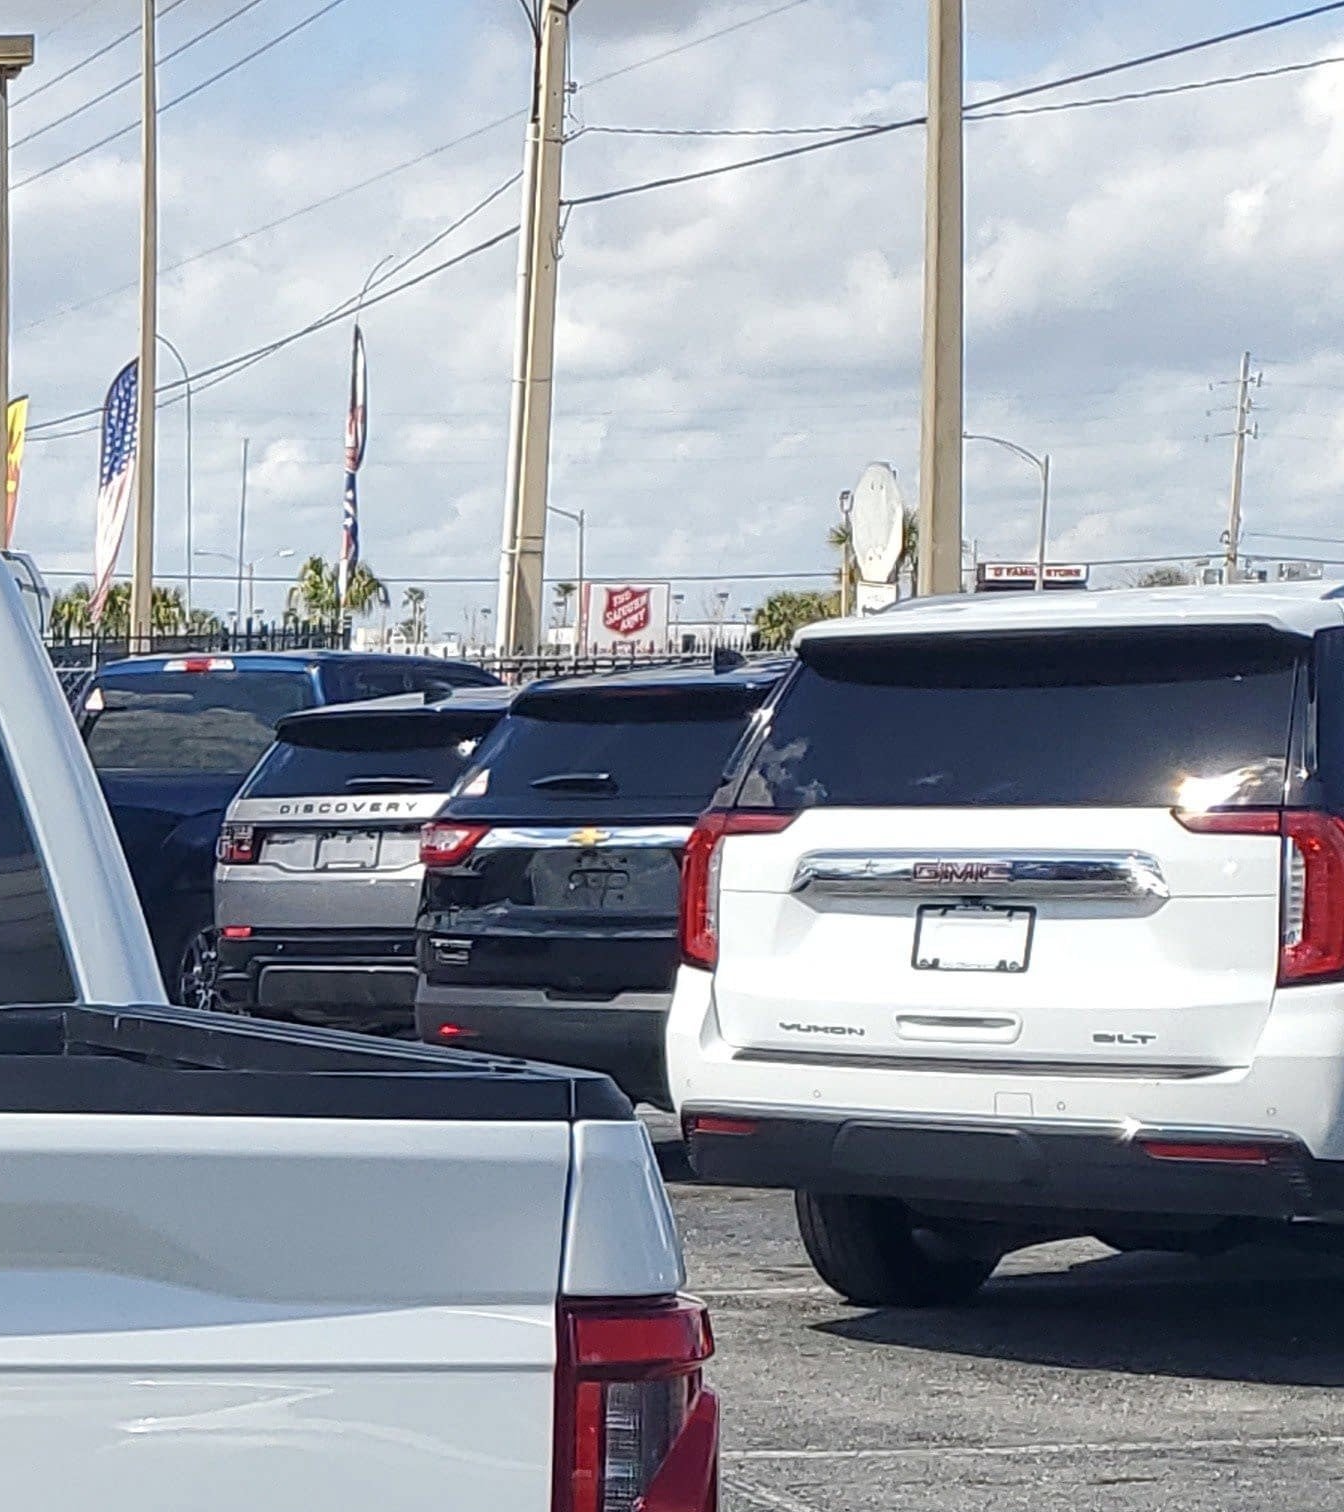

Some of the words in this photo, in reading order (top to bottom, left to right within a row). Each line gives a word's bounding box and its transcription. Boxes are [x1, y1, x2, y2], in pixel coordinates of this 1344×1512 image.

[279, 802, 418, 815] DISCOVERY
[914, 862, 1010, 883] GMC
[779, 1021, 866, 1037] YUKON
[1092, 1032, 1157, 1045] SLT
